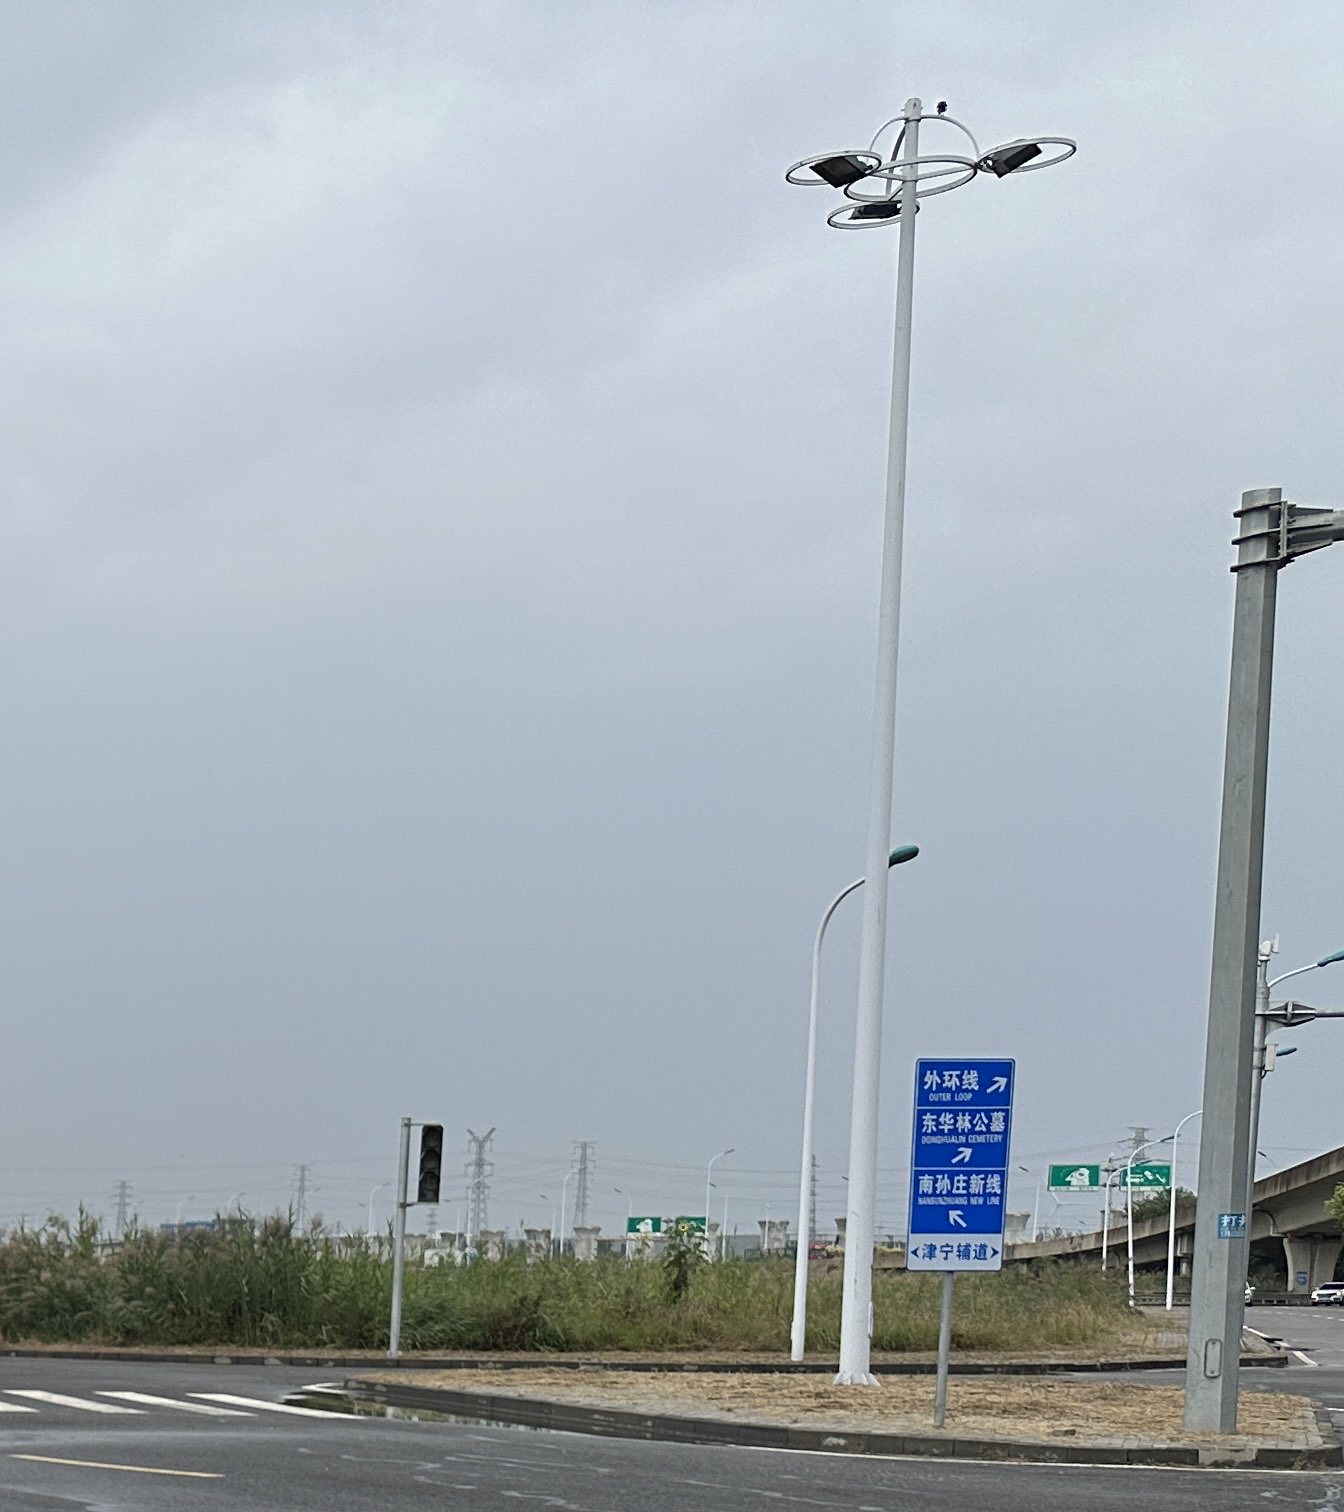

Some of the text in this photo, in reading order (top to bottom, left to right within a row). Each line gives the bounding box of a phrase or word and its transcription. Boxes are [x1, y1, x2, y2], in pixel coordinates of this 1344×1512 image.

[923, 1069, 979, 1092] 外环线
[928, 1092, 973, 1102] OUTER LOOP
[921, 1111, 1006, 1134] 东华林公墓
[967, 1133, 1003, 1143] CEMETERY
[918, 1173, 1001, 1195] 南孙庄新线
[922, 1242, 988, 1261] 津宁辅道
